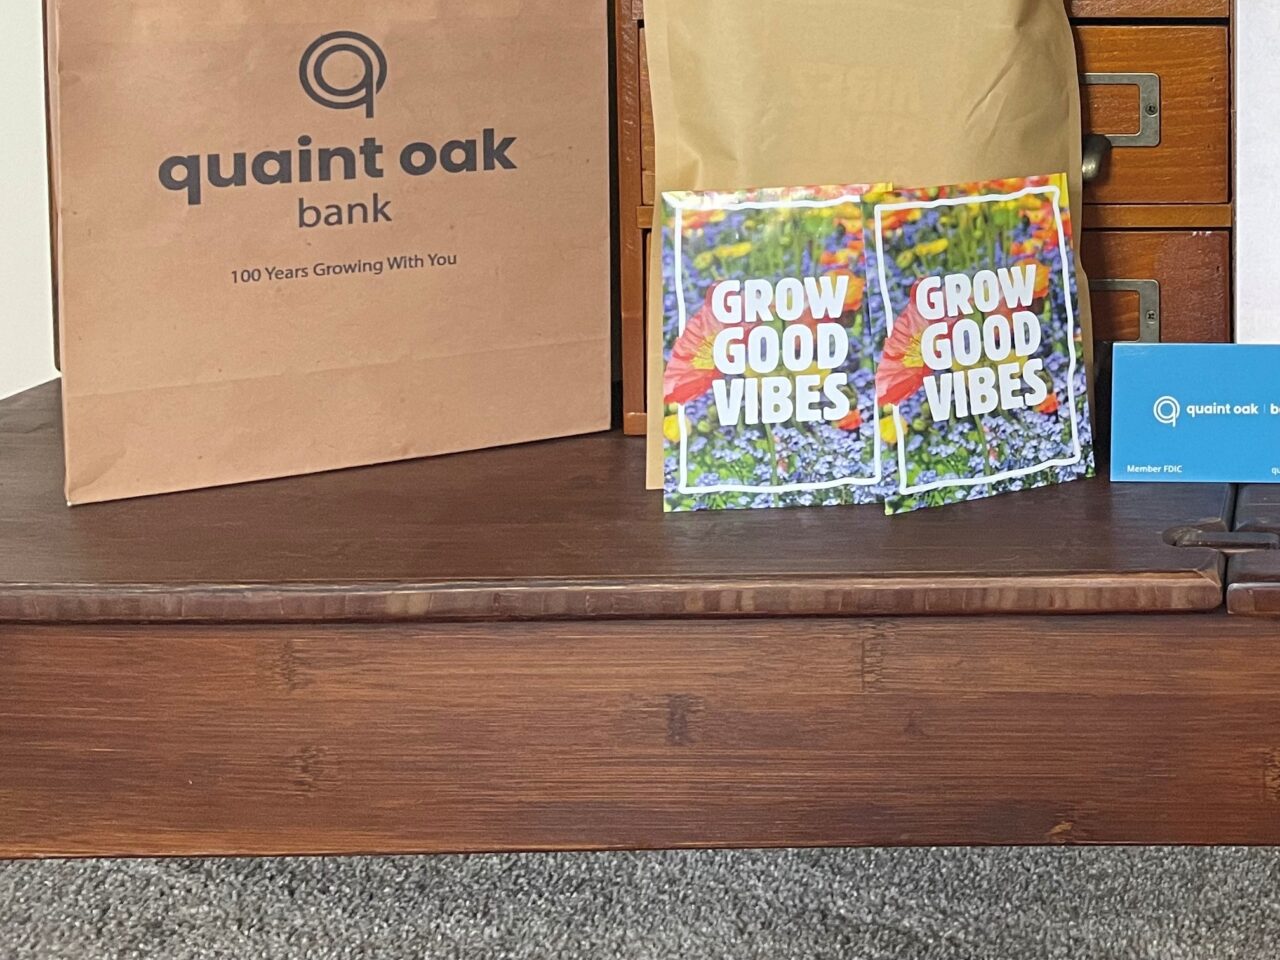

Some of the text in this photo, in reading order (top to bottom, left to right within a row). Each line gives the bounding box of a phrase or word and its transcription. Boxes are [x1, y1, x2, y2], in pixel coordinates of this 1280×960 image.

[158, 128, 518, 205] quaint oak
[297, 193, 393, 228] bank
[231, 252, 457, 284] 100 Years Growing With You
[915, 264, 1037, 321] GROW
[711, 275, 849, 323] GROW
[713, 322, 849, 375] GOOD
[921, 311, 1041, 370] GOOD
[712, 373, 850, 426] VIBES
[923, 358, 1048, 422] VIBES
[1186, 402, 1231, 416] quaint
[1233, 403, 1259, 415] oak
[1127, 464, 1183, 473] Member FDIC
